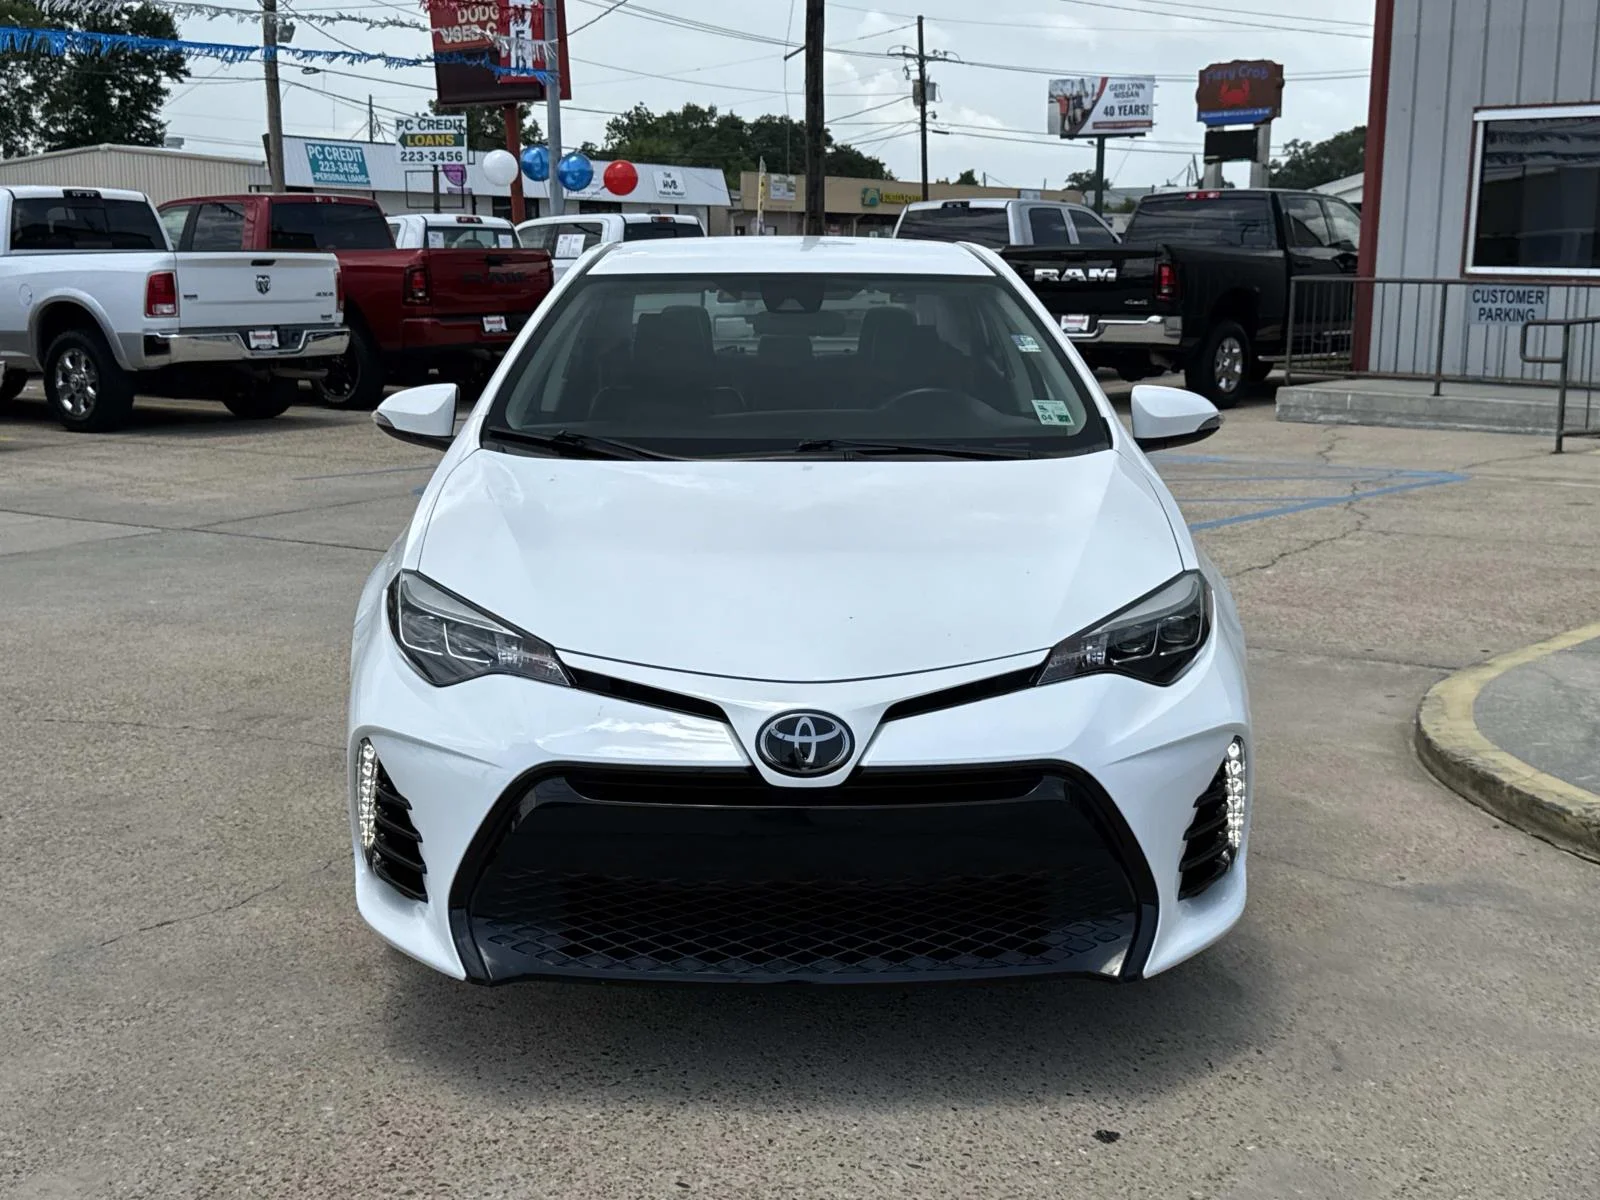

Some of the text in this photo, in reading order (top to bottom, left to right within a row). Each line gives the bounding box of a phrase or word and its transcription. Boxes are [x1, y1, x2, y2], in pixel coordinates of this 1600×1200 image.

[1114, 91, 1140, 99] NISSAN
[1103, 103, 1150, 117] 40 YEARS!
[396, 118, 465, 131] PC CREDIT
[406, 134, 455, 146] LOANS
[307, 145, 363, 162] PC CREDIT
[400, 151, 464, 162] 223-3456
[318, 161, 361, 174] 223-3456
[1034, 268, 1118, 282] RAM
[1472, 289, 1545, 304] CUSTOMER
[1478, 307, 1536, 322] PARKING
